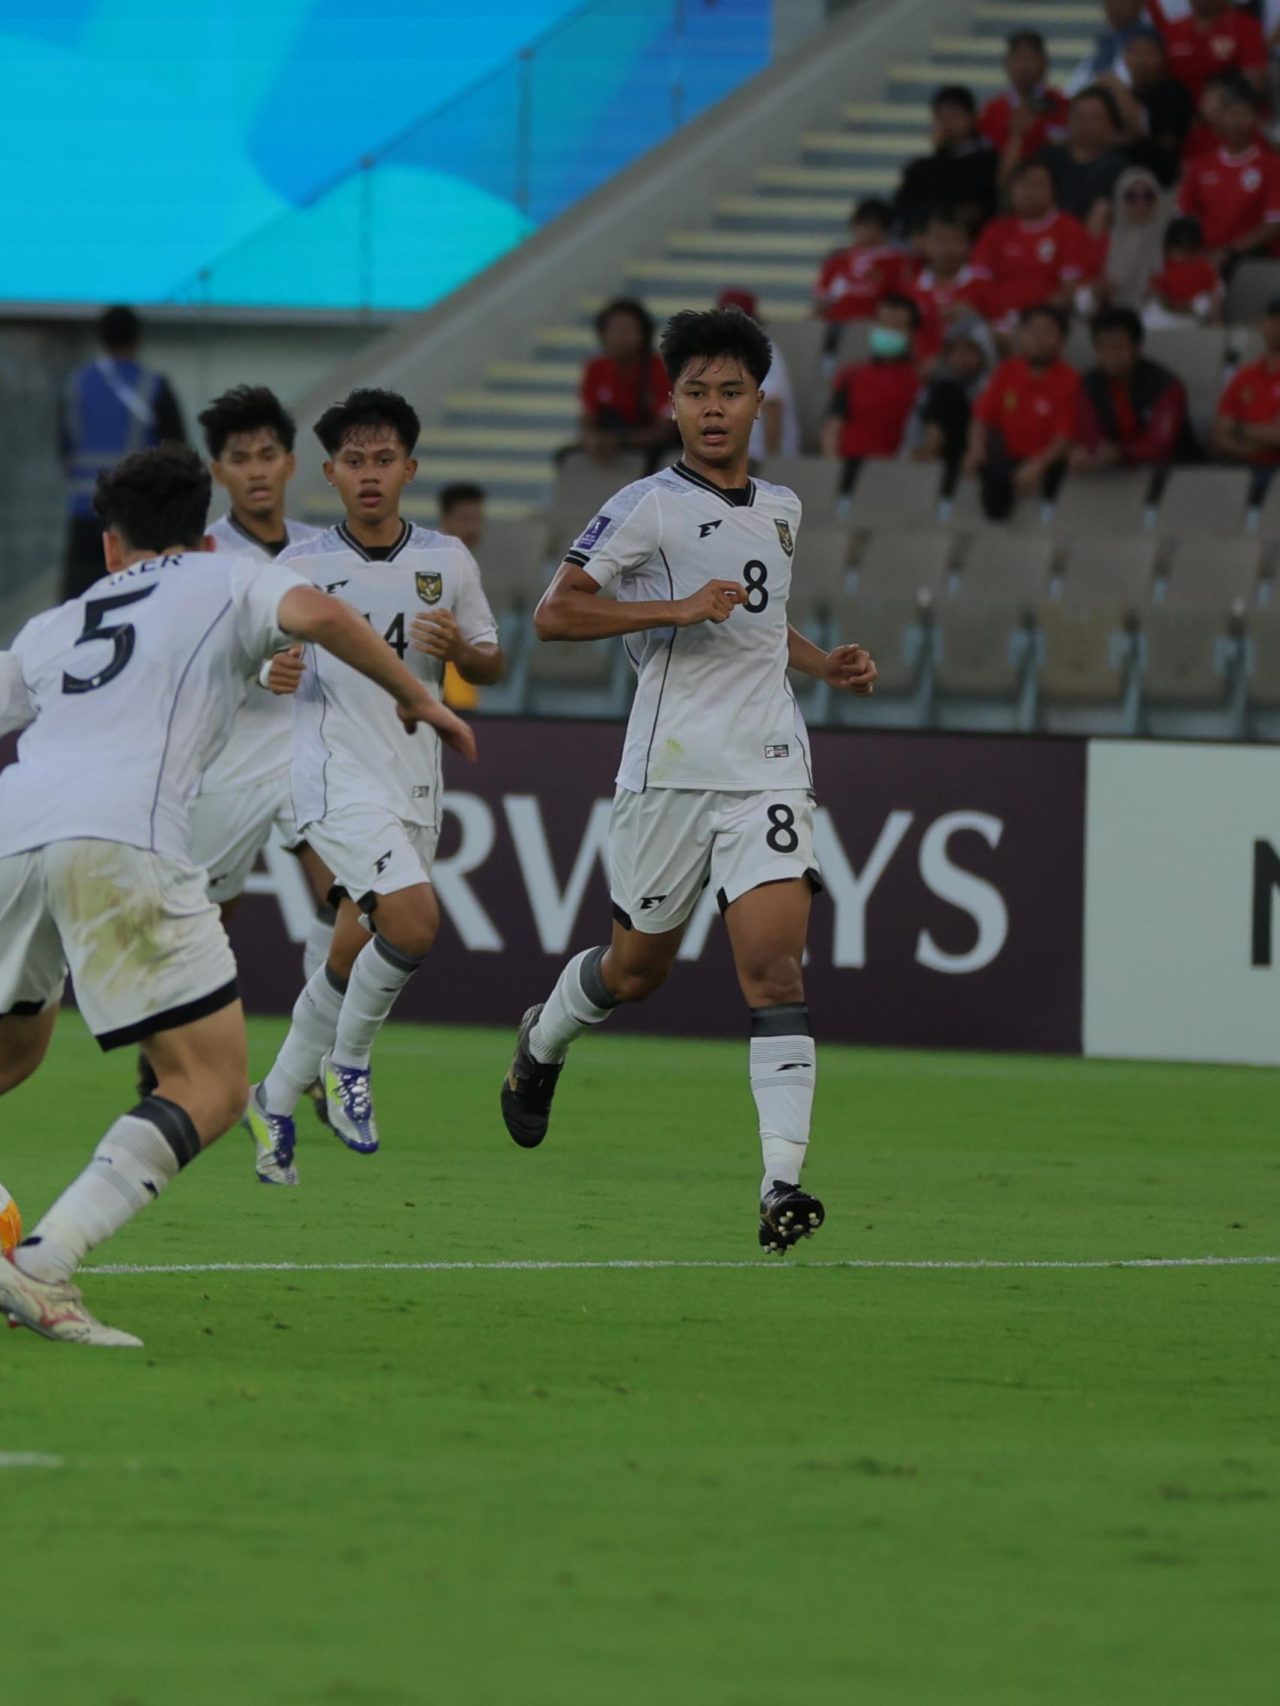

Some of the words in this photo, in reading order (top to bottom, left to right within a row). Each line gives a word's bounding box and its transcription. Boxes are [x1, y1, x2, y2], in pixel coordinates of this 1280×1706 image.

[743, 559, 769, 614] 8
[61, 582, 159, 695] 5
[765, 803, 799, 853] 8
